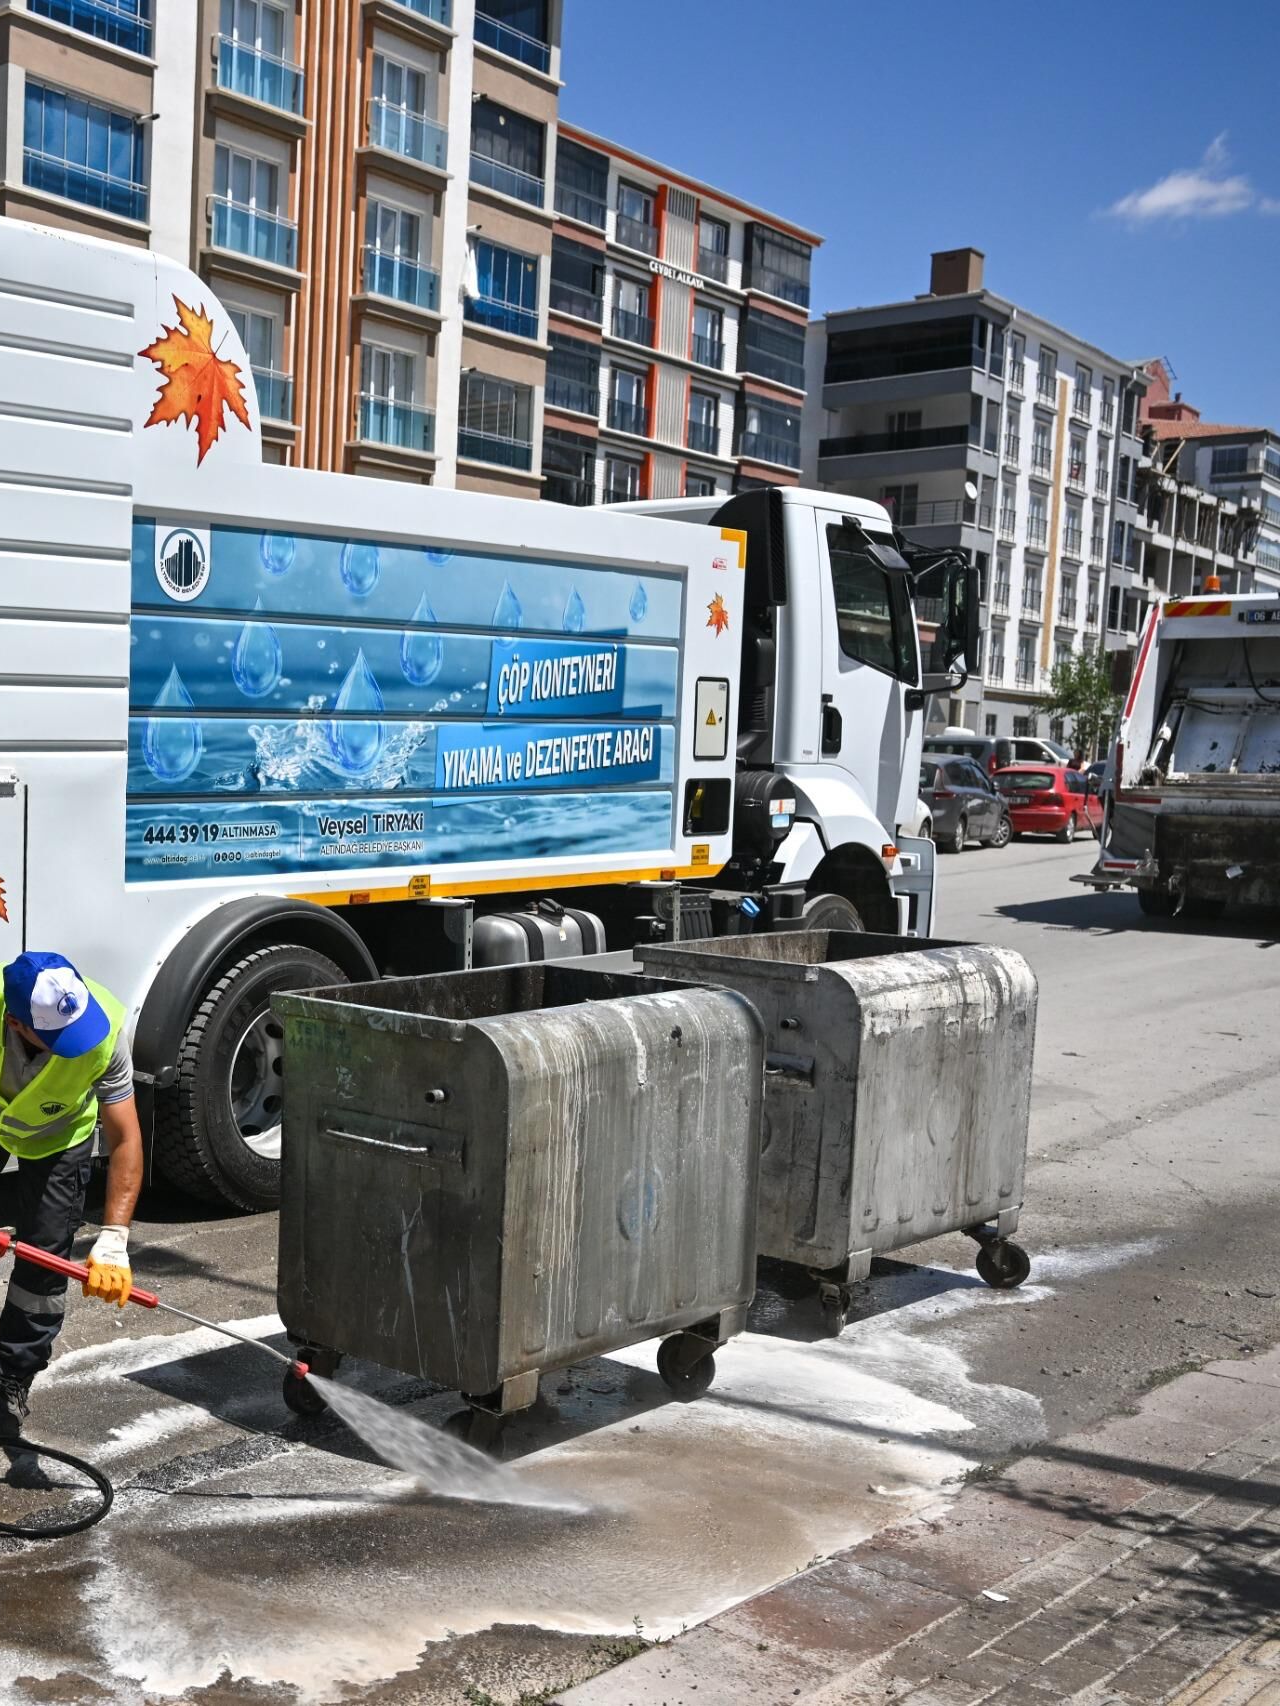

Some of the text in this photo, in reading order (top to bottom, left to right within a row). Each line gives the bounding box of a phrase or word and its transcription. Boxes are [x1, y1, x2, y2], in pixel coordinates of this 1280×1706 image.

[649, 261, 705, 290] CEVDET ALKAYA
[1254, 612, 1265, 621] 06
[498, 644, 618, 714] ÇÖP KONTEYNERİ
[443, 727, 654, 788] YIKAMA ve DEZENFEKTE ARACI
[143, 824, 277, 844] 444 39 19 ALTINMASA
[318, 815, 366, 839] Veysel
[320, 840, 424, 855] ALTINDAĞ BELEDİYE BAŞKANI
